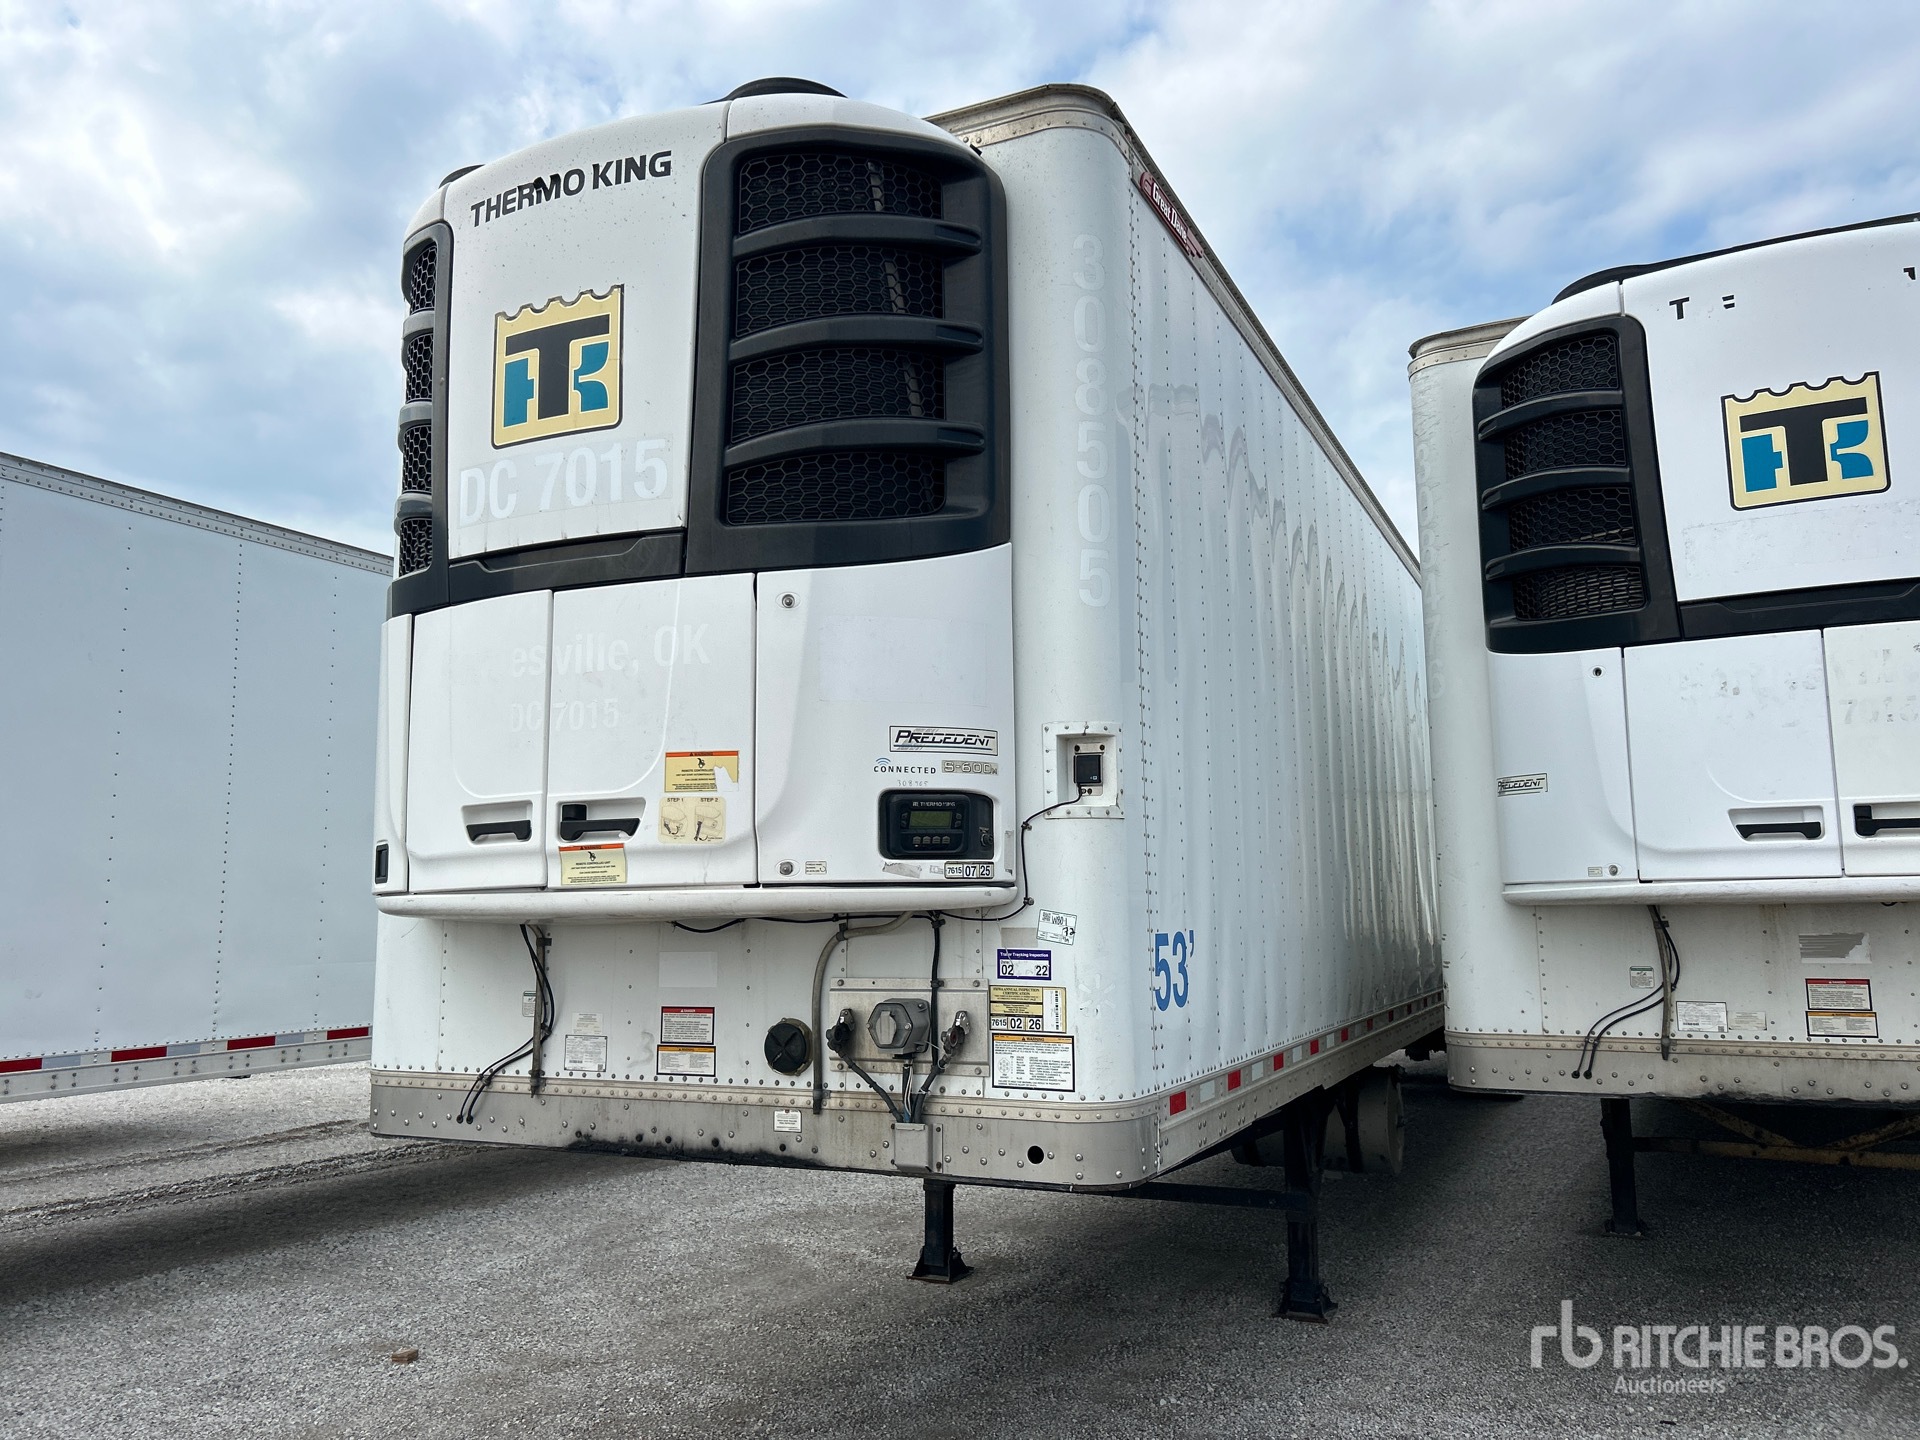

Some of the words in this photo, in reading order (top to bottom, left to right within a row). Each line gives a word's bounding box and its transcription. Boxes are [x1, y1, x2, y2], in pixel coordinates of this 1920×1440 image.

[471, 168, 585, 227] THERMO
[592, 150, 672, 189] KING
[1152, 182, 1171, 221] Great
[1170, 207, 1187, 243] Dane
[459, 459, 517, 527] DC
[534, 438, 668, 511] 7015
[654, 623, 711, 667] OK
[551, 697, 621, 731] 7015
[895, 729, 996, 747] PRECEDENT
[873, 765, 937, 775] CONNECTED
[1498, 777, 1546, 790] PRECEDENT
[947, 866, 962, 874] 7615
[965, 865, 977, 877] 07
[980, 865, 991, 877] 25
[1001, 964, 1014, 976] 02
[1035, 965, 1048, 976] 22
[992, 1018, 1007, 1027] 7615
[1010, 1017, 1022, 1029] 02
[1028, 1019, 1041, 1030] 26
